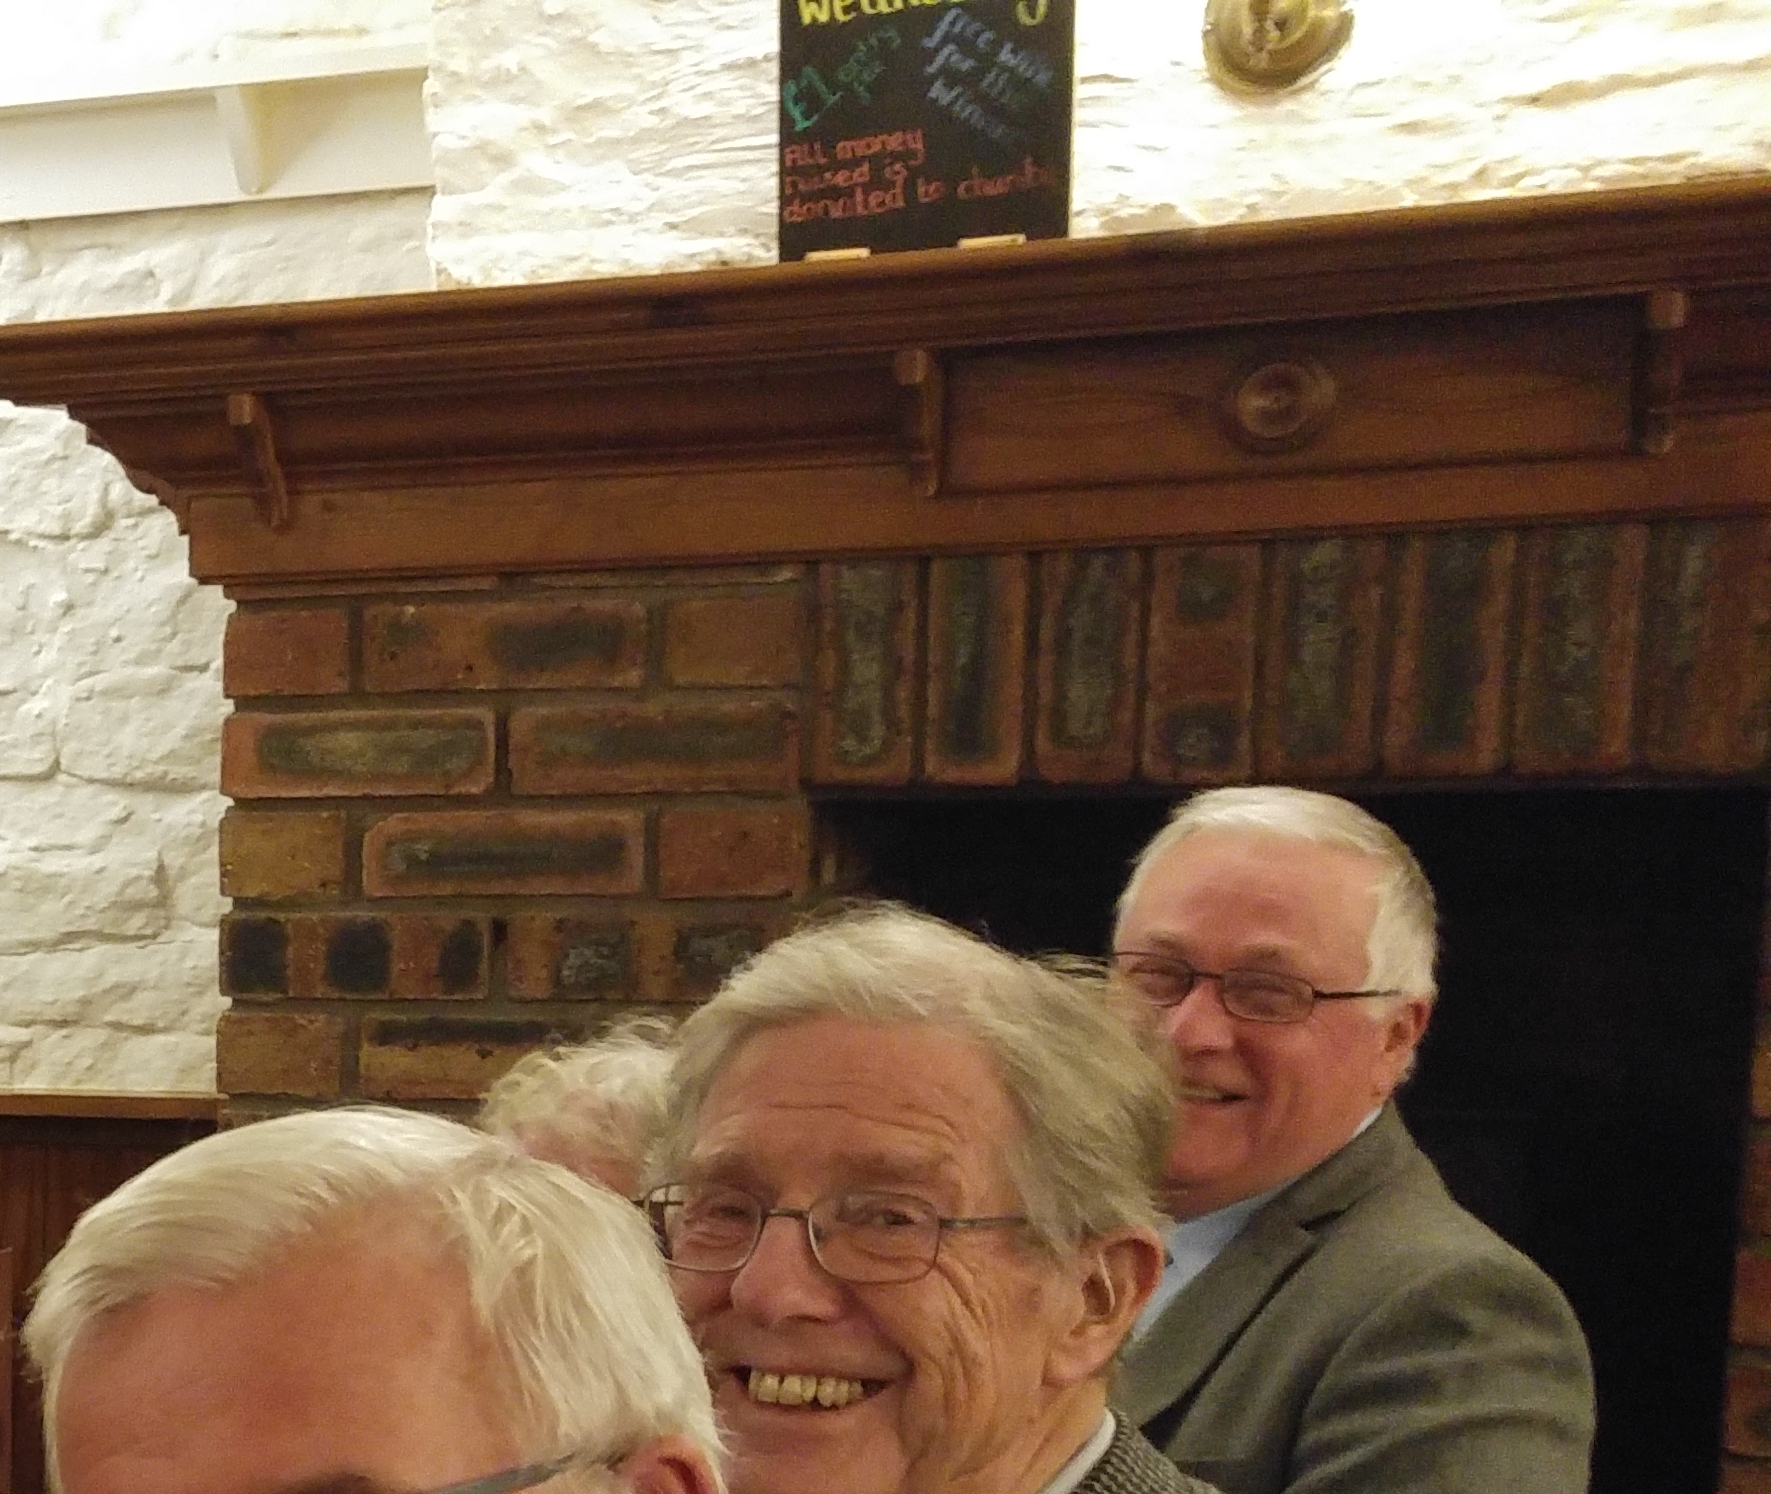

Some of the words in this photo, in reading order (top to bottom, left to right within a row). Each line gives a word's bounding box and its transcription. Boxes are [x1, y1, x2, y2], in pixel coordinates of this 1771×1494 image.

[836, 129, 925, 166] money
[783, 179, 906, 222] donated
[918, 177, 945, 203] to
